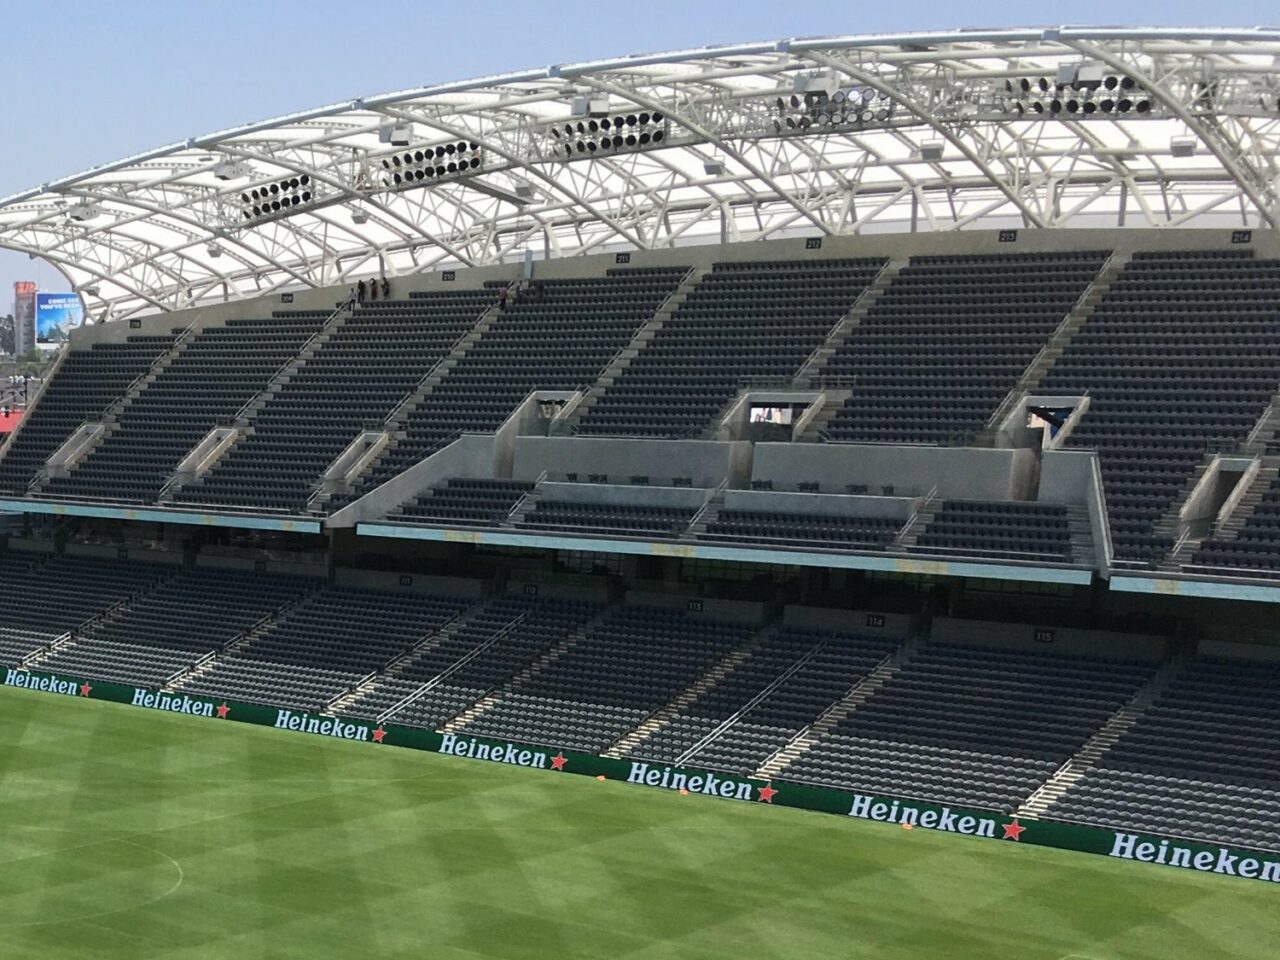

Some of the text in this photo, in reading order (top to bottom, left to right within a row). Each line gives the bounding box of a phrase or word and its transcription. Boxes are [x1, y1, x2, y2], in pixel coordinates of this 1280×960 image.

[4, 669, 78, 696] Heineken
[131, 688, 214, 717] Heineken
[274, 709, 369, 741] Heineken
[438, 734, 546, 769] Heineken
[627, 762, 752, 800] Heineken
[848, 794, 996, 837] Heineken
[1109, 832, 1280, 883] Heineken
